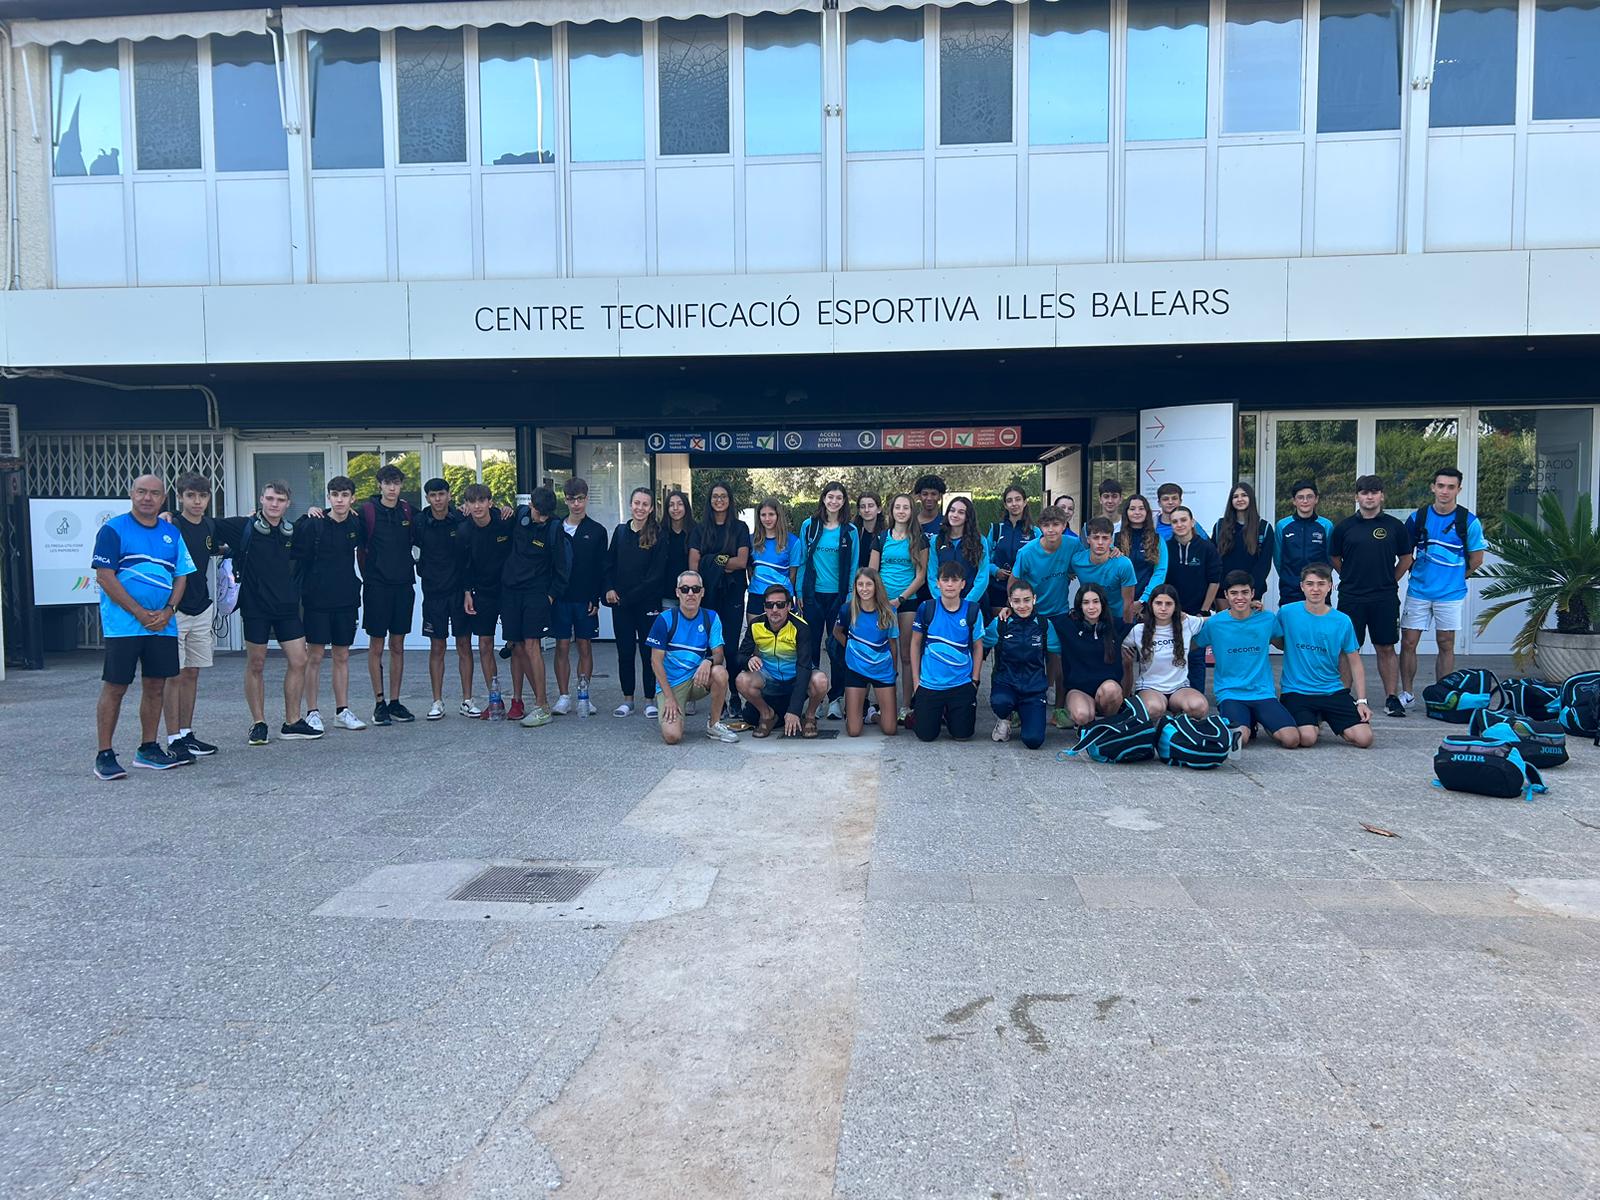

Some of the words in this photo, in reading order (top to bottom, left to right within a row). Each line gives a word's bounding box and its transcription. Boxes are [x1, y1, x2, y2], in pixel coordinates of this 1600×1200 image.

[475, 305, 585, 332] CENTRE
[600, 294, 800, 330] TECNIFICACIÓ
[818, 296, 980, 325] ESPORTIVA
[998, 292, 1076, 320] ILLES
[1092, 288, 1230, 318] BALEARS
[1227, 646, 1261, 654] cecome
[1295, 643, 1328, 653] cecome
